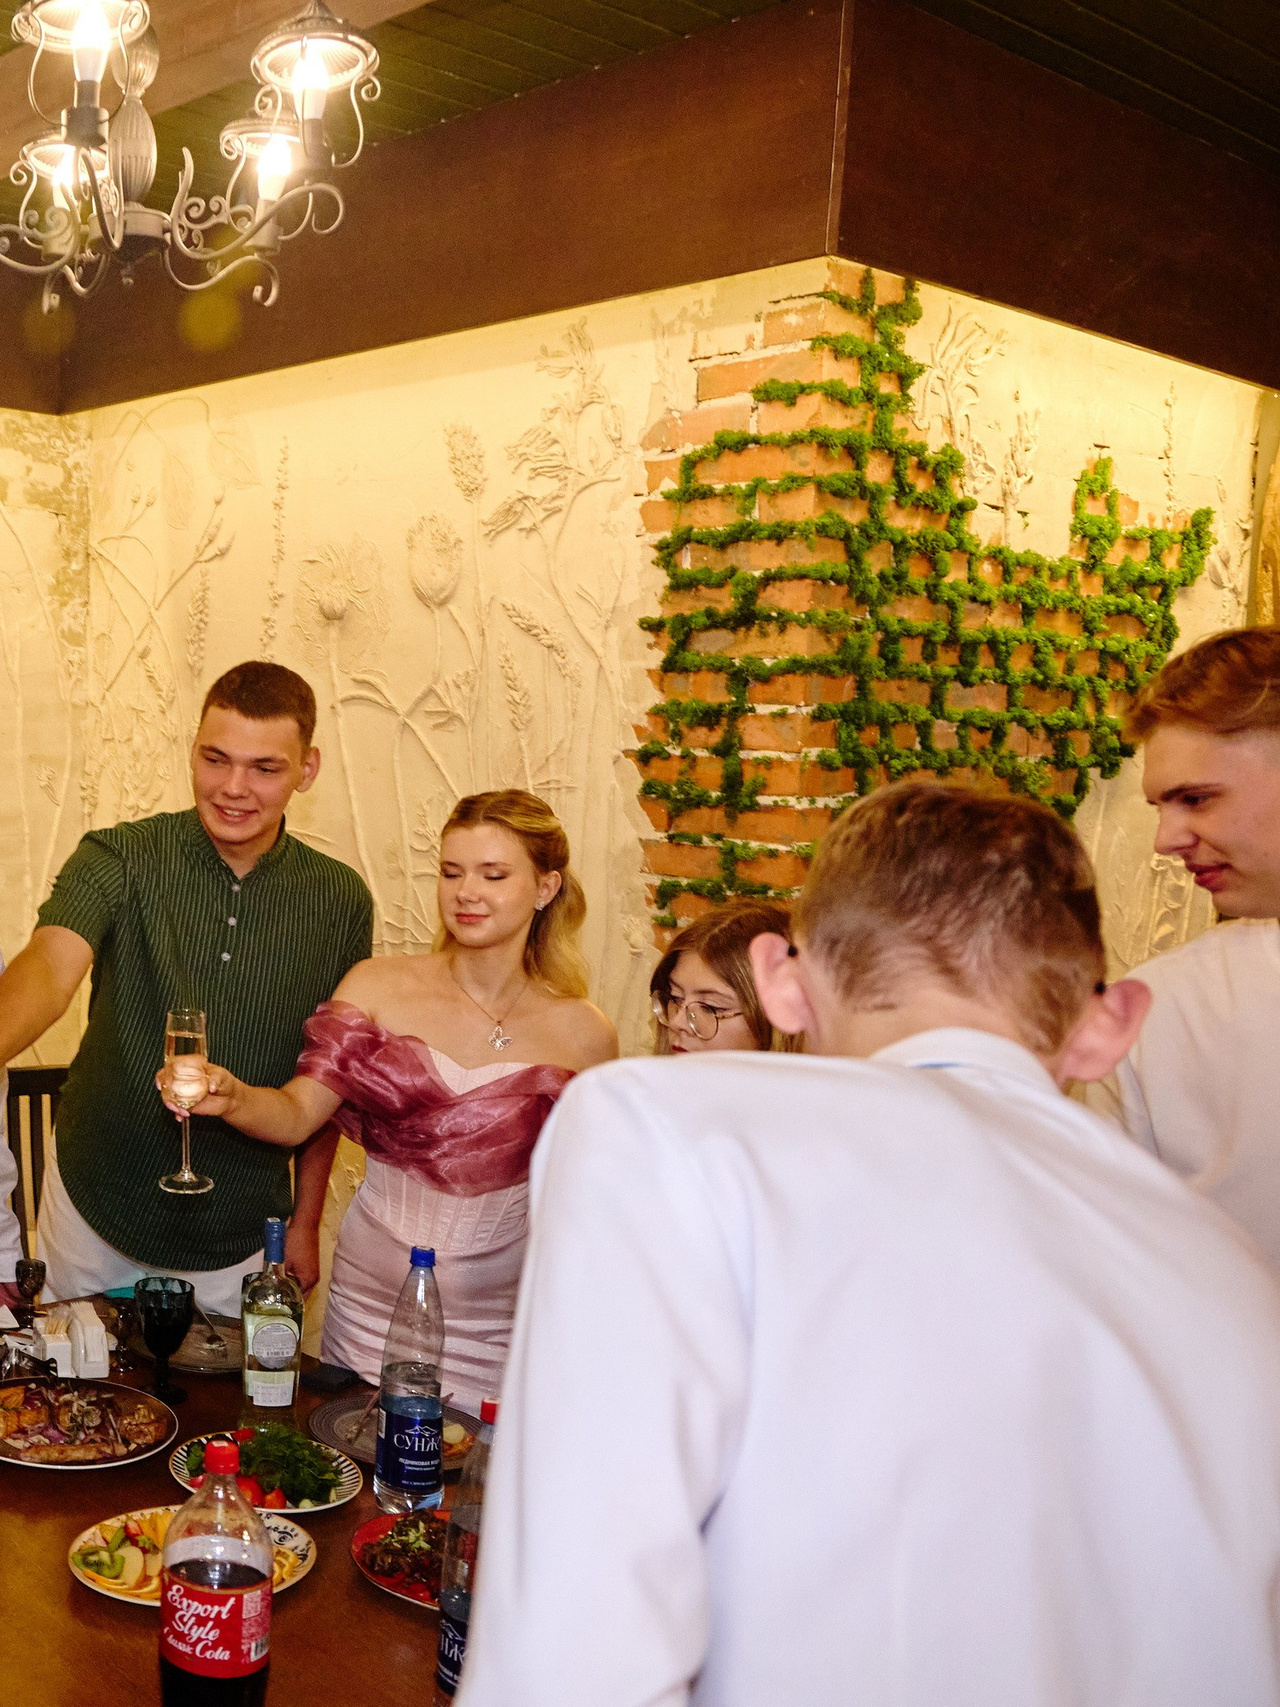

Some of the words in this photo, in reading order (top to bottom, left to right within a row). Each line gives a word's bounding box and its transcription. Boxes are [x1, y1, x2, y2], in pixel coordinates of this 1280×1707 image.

[394, 1434, 441, 1452] СУНЖ
[167, 1585, 235, 1622] Export
[172, 1611, 220, 1643] Style
[195, 1640, 231, 1660] Cola
